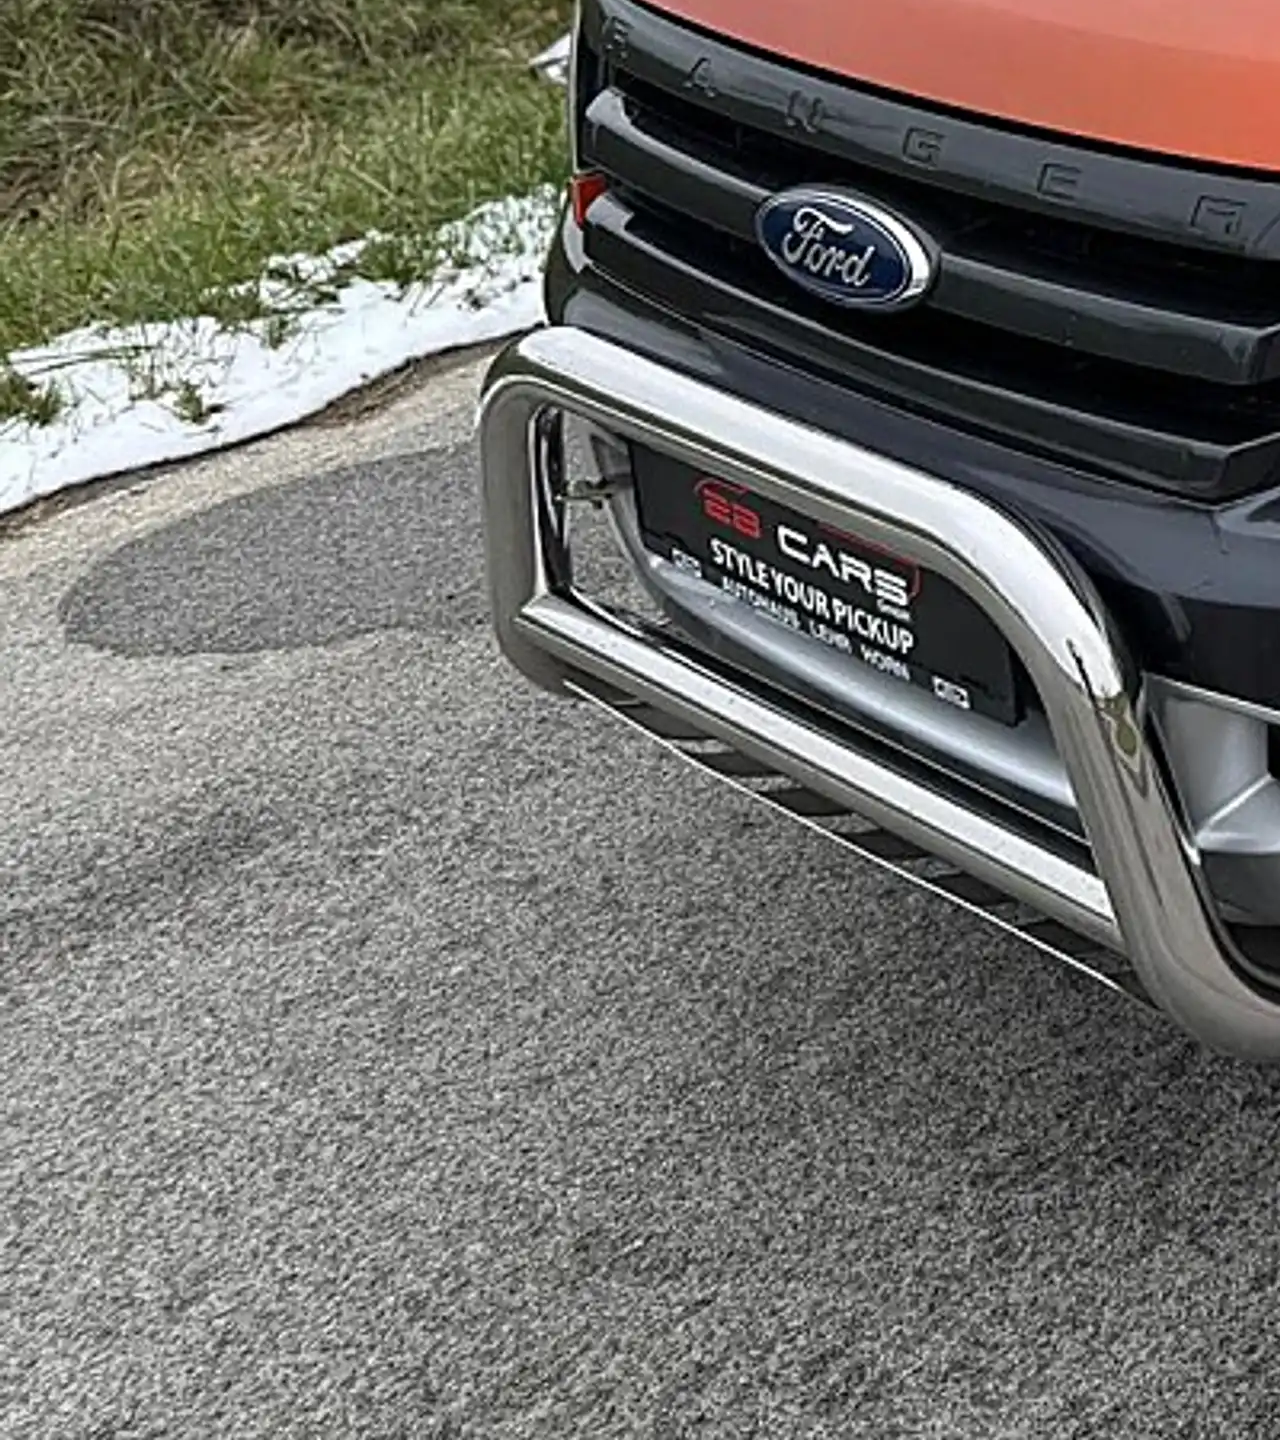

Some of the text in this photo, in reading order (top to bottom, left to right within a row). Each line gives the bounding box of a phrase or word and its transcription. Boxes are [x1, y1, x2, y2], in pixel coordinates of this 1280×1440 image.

[781, 206, 875, 287] Ford
[709, 537, 770, 591] STYLE
[770, 569, 830, 620] YOUR
[831, 597, 915, 654] PICKUP
[776, 524, 909, 607] CARS
